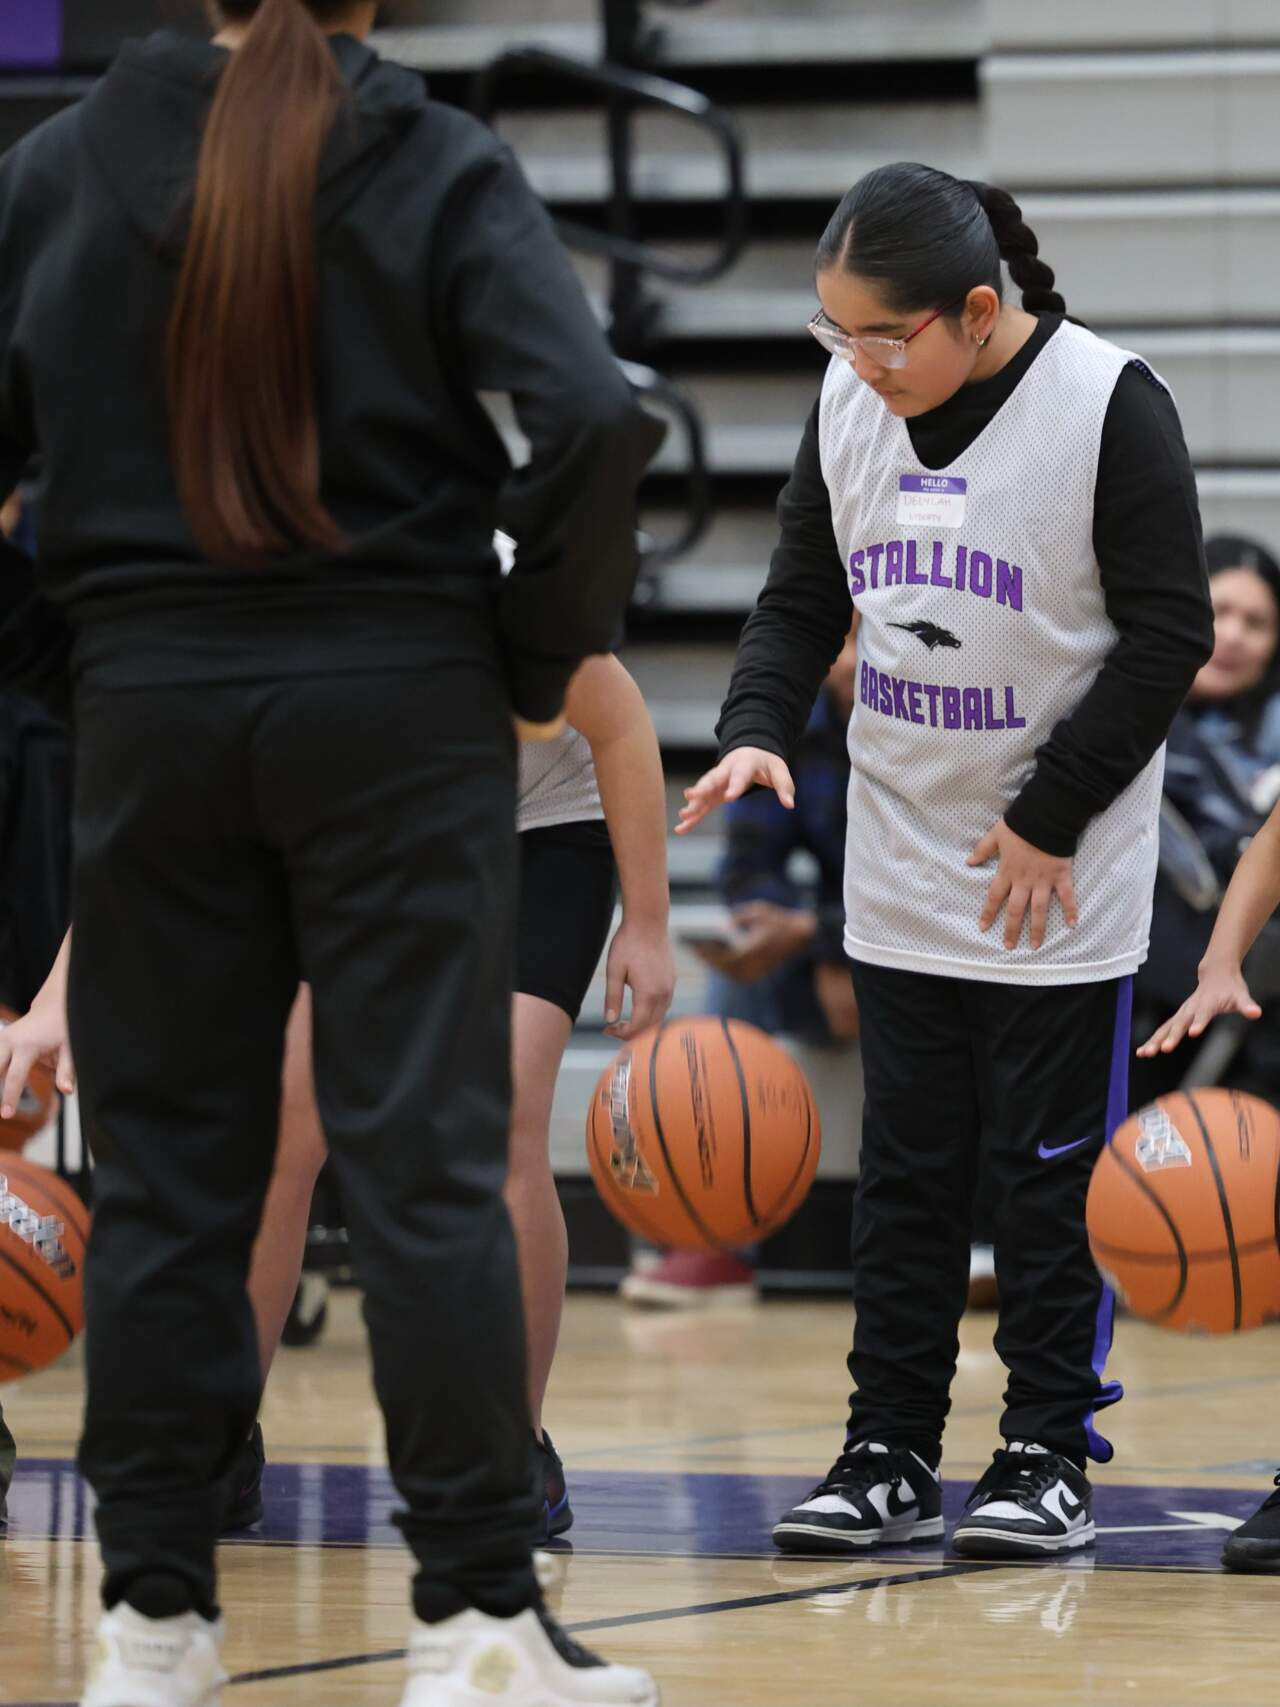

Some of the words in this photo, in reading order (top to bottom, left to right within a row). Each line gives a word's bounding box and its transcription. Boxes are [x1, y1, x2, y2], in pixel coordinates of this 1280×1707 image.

[920, 477, 948, 487] HELLO
[850, 540, 1023, 612] STALLION
[860, 660, 1027, 731] BASKETBALL
